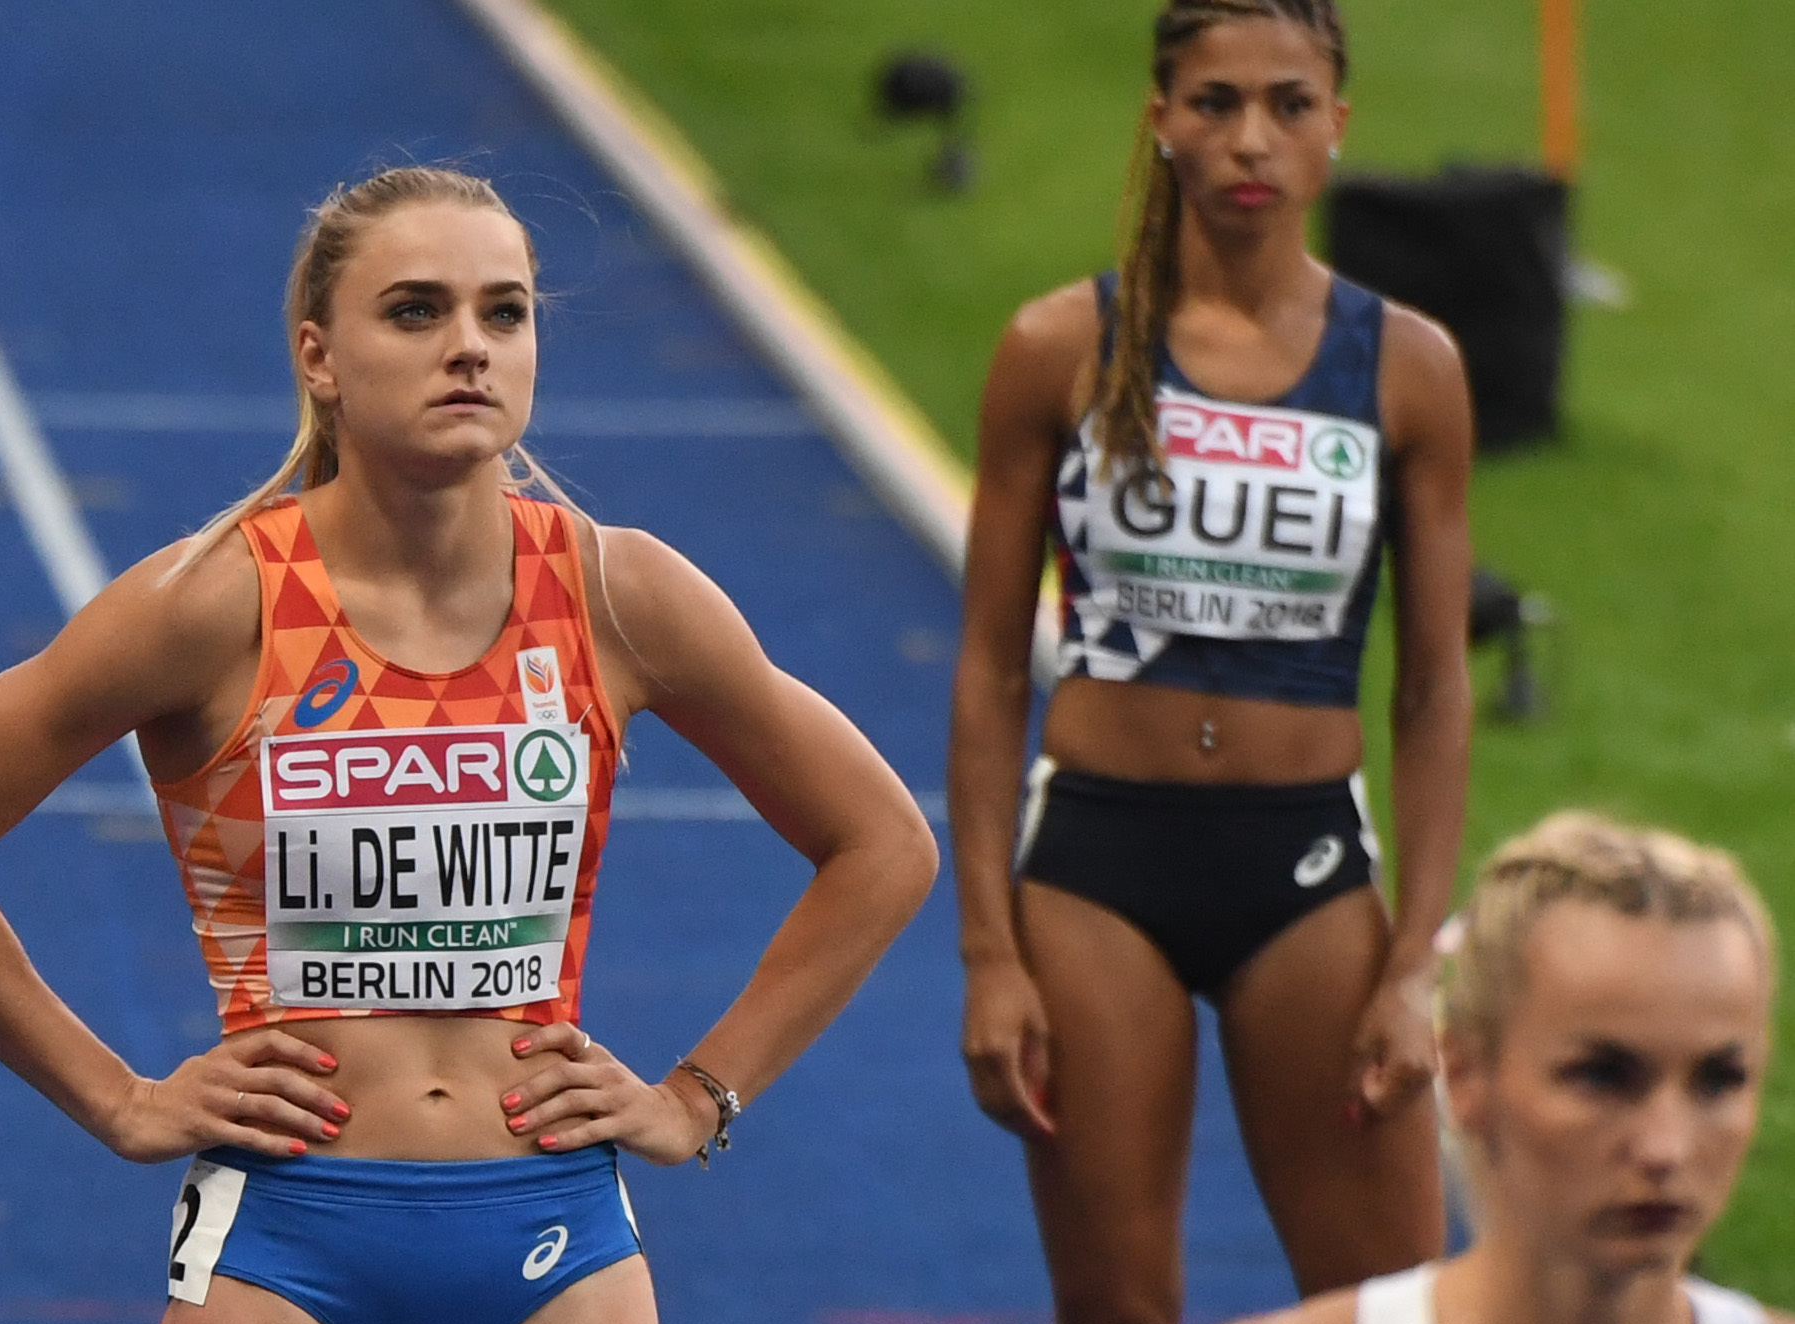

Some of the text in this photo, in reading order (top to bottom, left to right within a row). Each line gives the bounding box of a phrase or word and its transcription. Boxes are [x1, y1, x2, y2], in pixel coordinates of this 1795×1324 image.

[1160, 409, 1298, 464] PAR
[1111, 470, 1346, 559] GUEI
[1116, 580, 1234, 625] BERLIN
[276, 742, 501, 800] SPAR
[278, 820, 573, 909] Li. DE WITTE
[360, 926, 418, 948] RUN
[302, 955, 542, 999] BERLIN 2018
